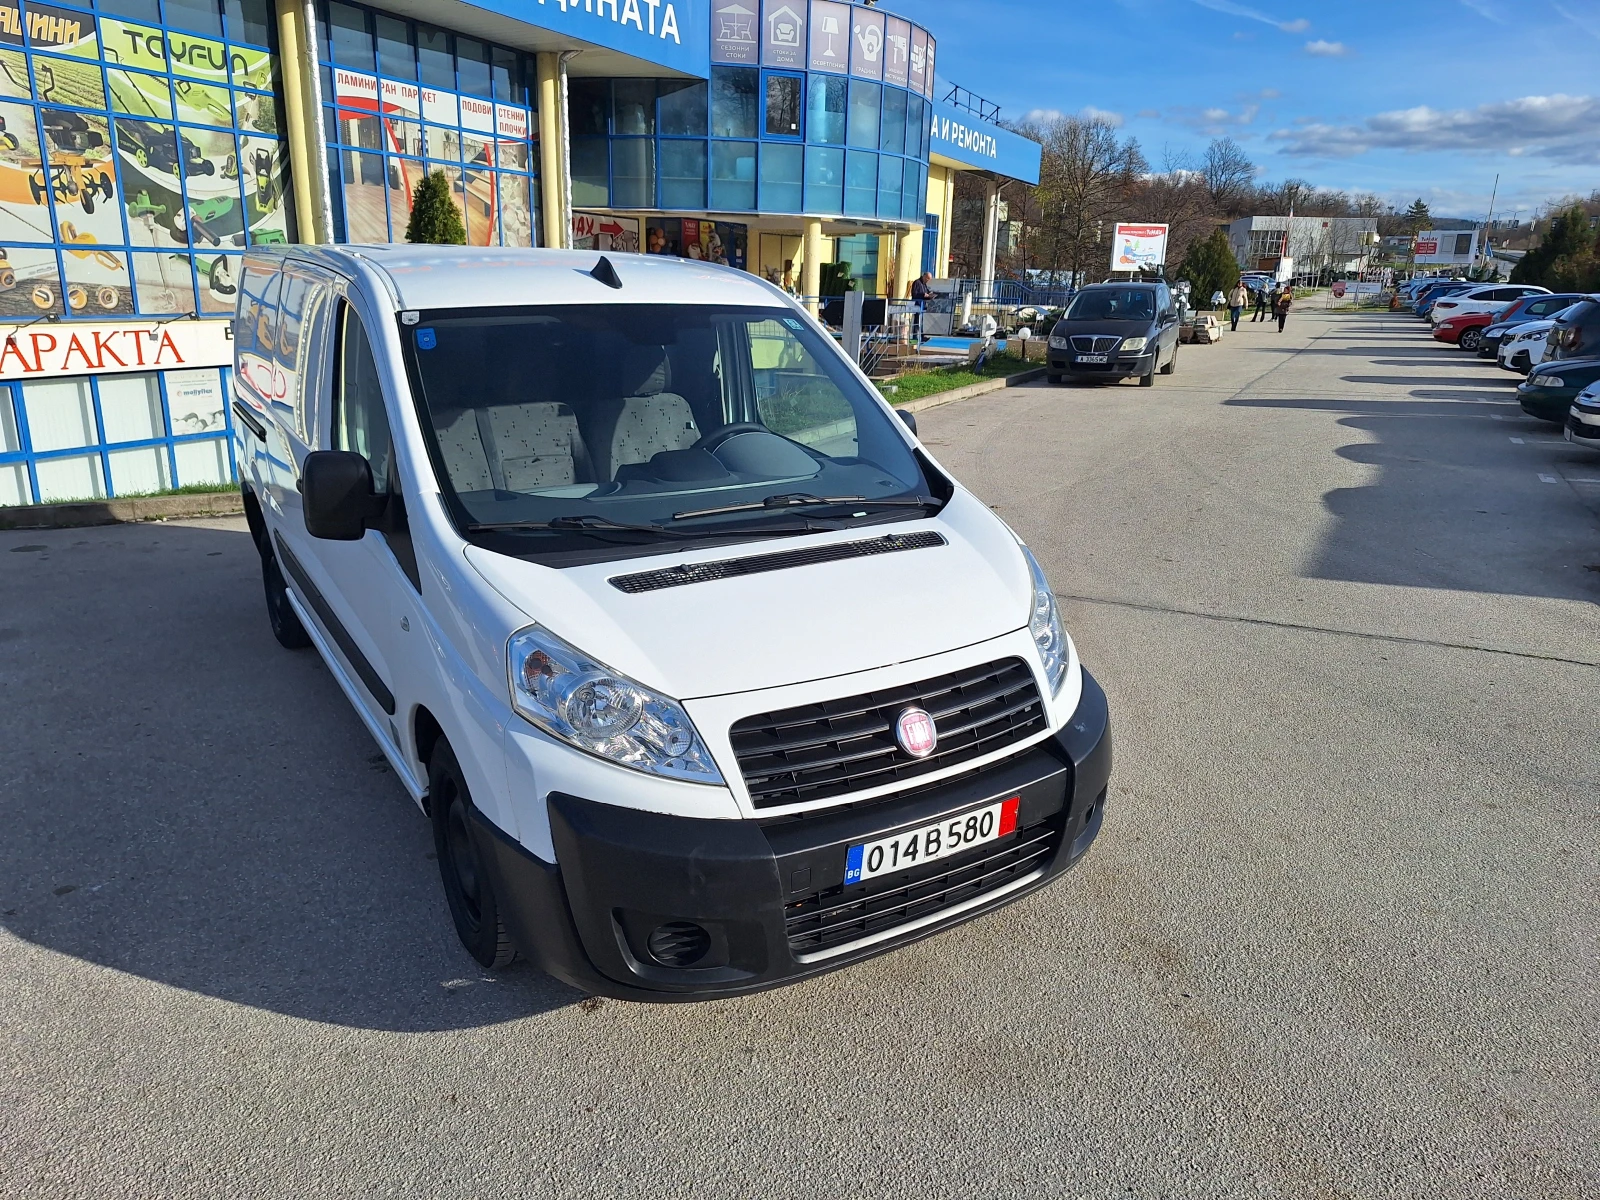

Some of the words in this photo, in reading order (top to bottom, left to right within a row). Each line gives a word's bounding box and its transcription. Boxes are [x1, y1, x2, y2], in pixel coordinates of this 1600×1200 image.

[537, 0, 681, 45] НАТА
[720, 44, 750, 52] СЕЗОННИ
[812, 60, 845, 69] ОСВЕТЛЕНИЕ
[855, 66, 877, 75] ГРАДИНА
[337, 72, 397, 95] ЛАМИНИРАН
[401, 86, 437, 104] ПАРКЕТ
[462, 100, 492, 116] ПОДОВИ
[498, 108, 525, 122] СТЕННИ
[499, 123, 527, 136] ПЛОЧКИ
[941, 117, 950, 141] И
[951, 121, 997, 159] РЕМОНТА
[0, 329, 186, 374] АРАКТА
[847, 868, 861, 879] BG
